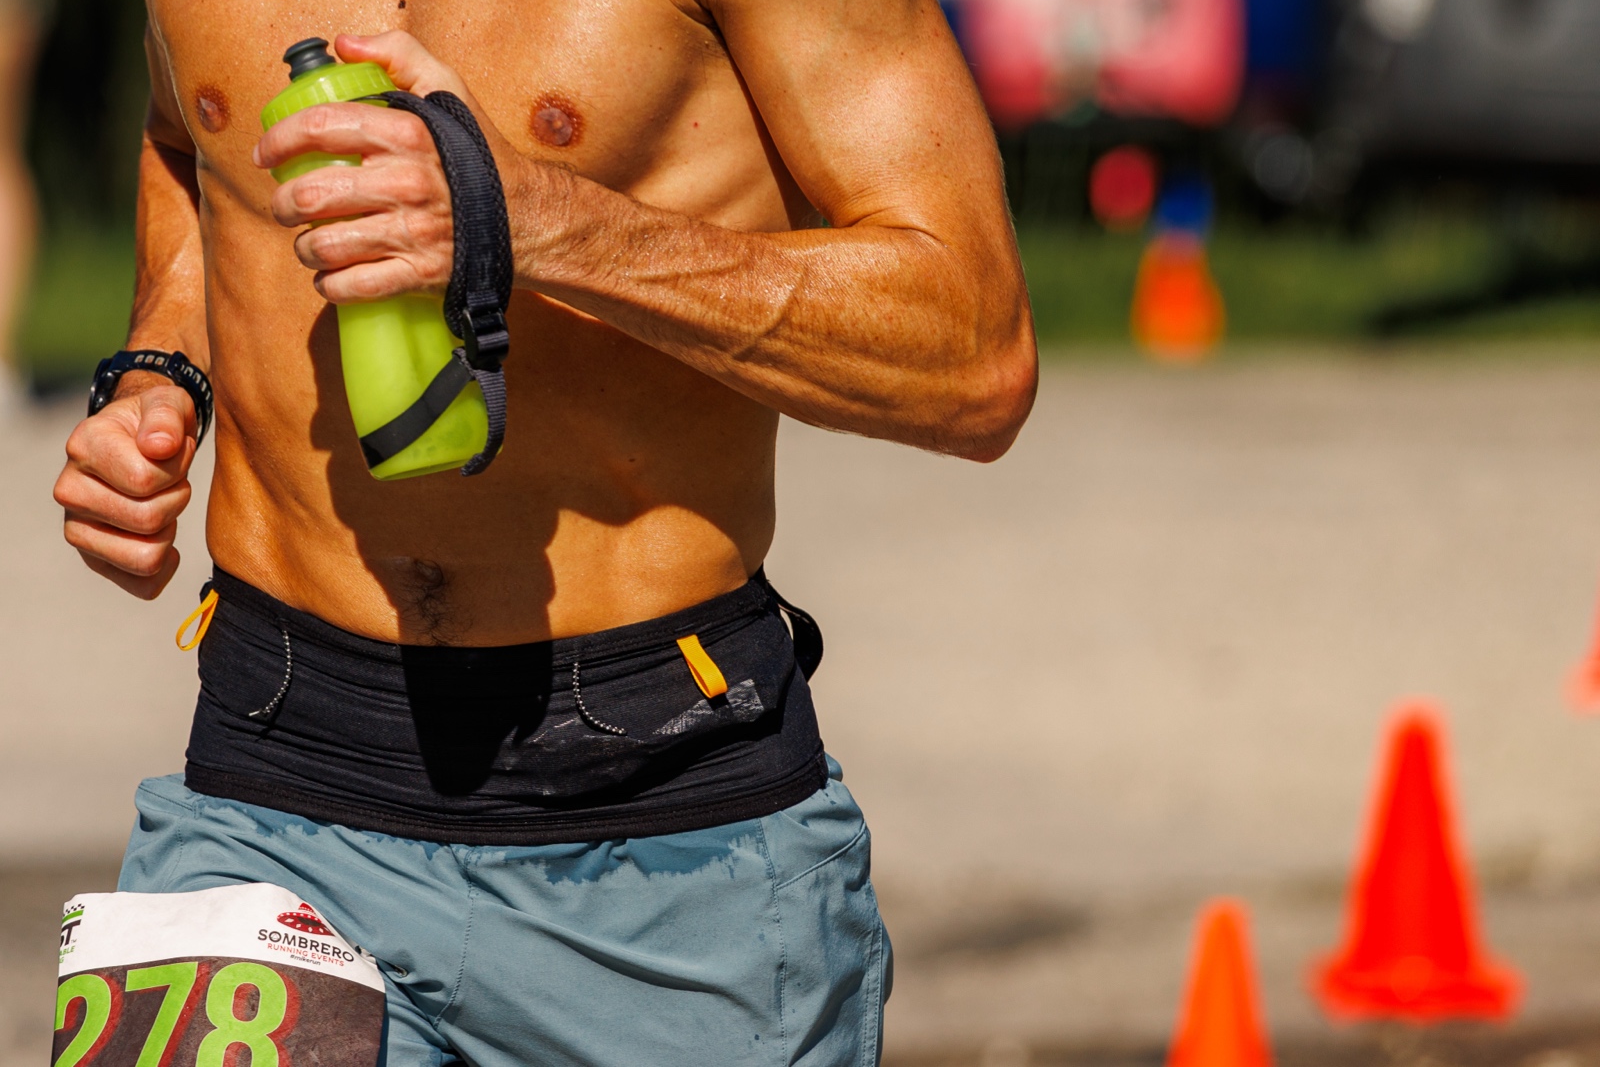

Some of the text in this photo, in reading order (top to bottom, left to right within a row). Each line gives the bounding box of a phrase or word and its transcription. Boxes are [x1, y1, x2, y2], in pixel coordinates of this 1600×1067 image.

[257, 928, 355, 963] SOMBRERO
[267, 942, 345, 967] RUNNING EVENTS
[53, 961, 289, 1067] 278
